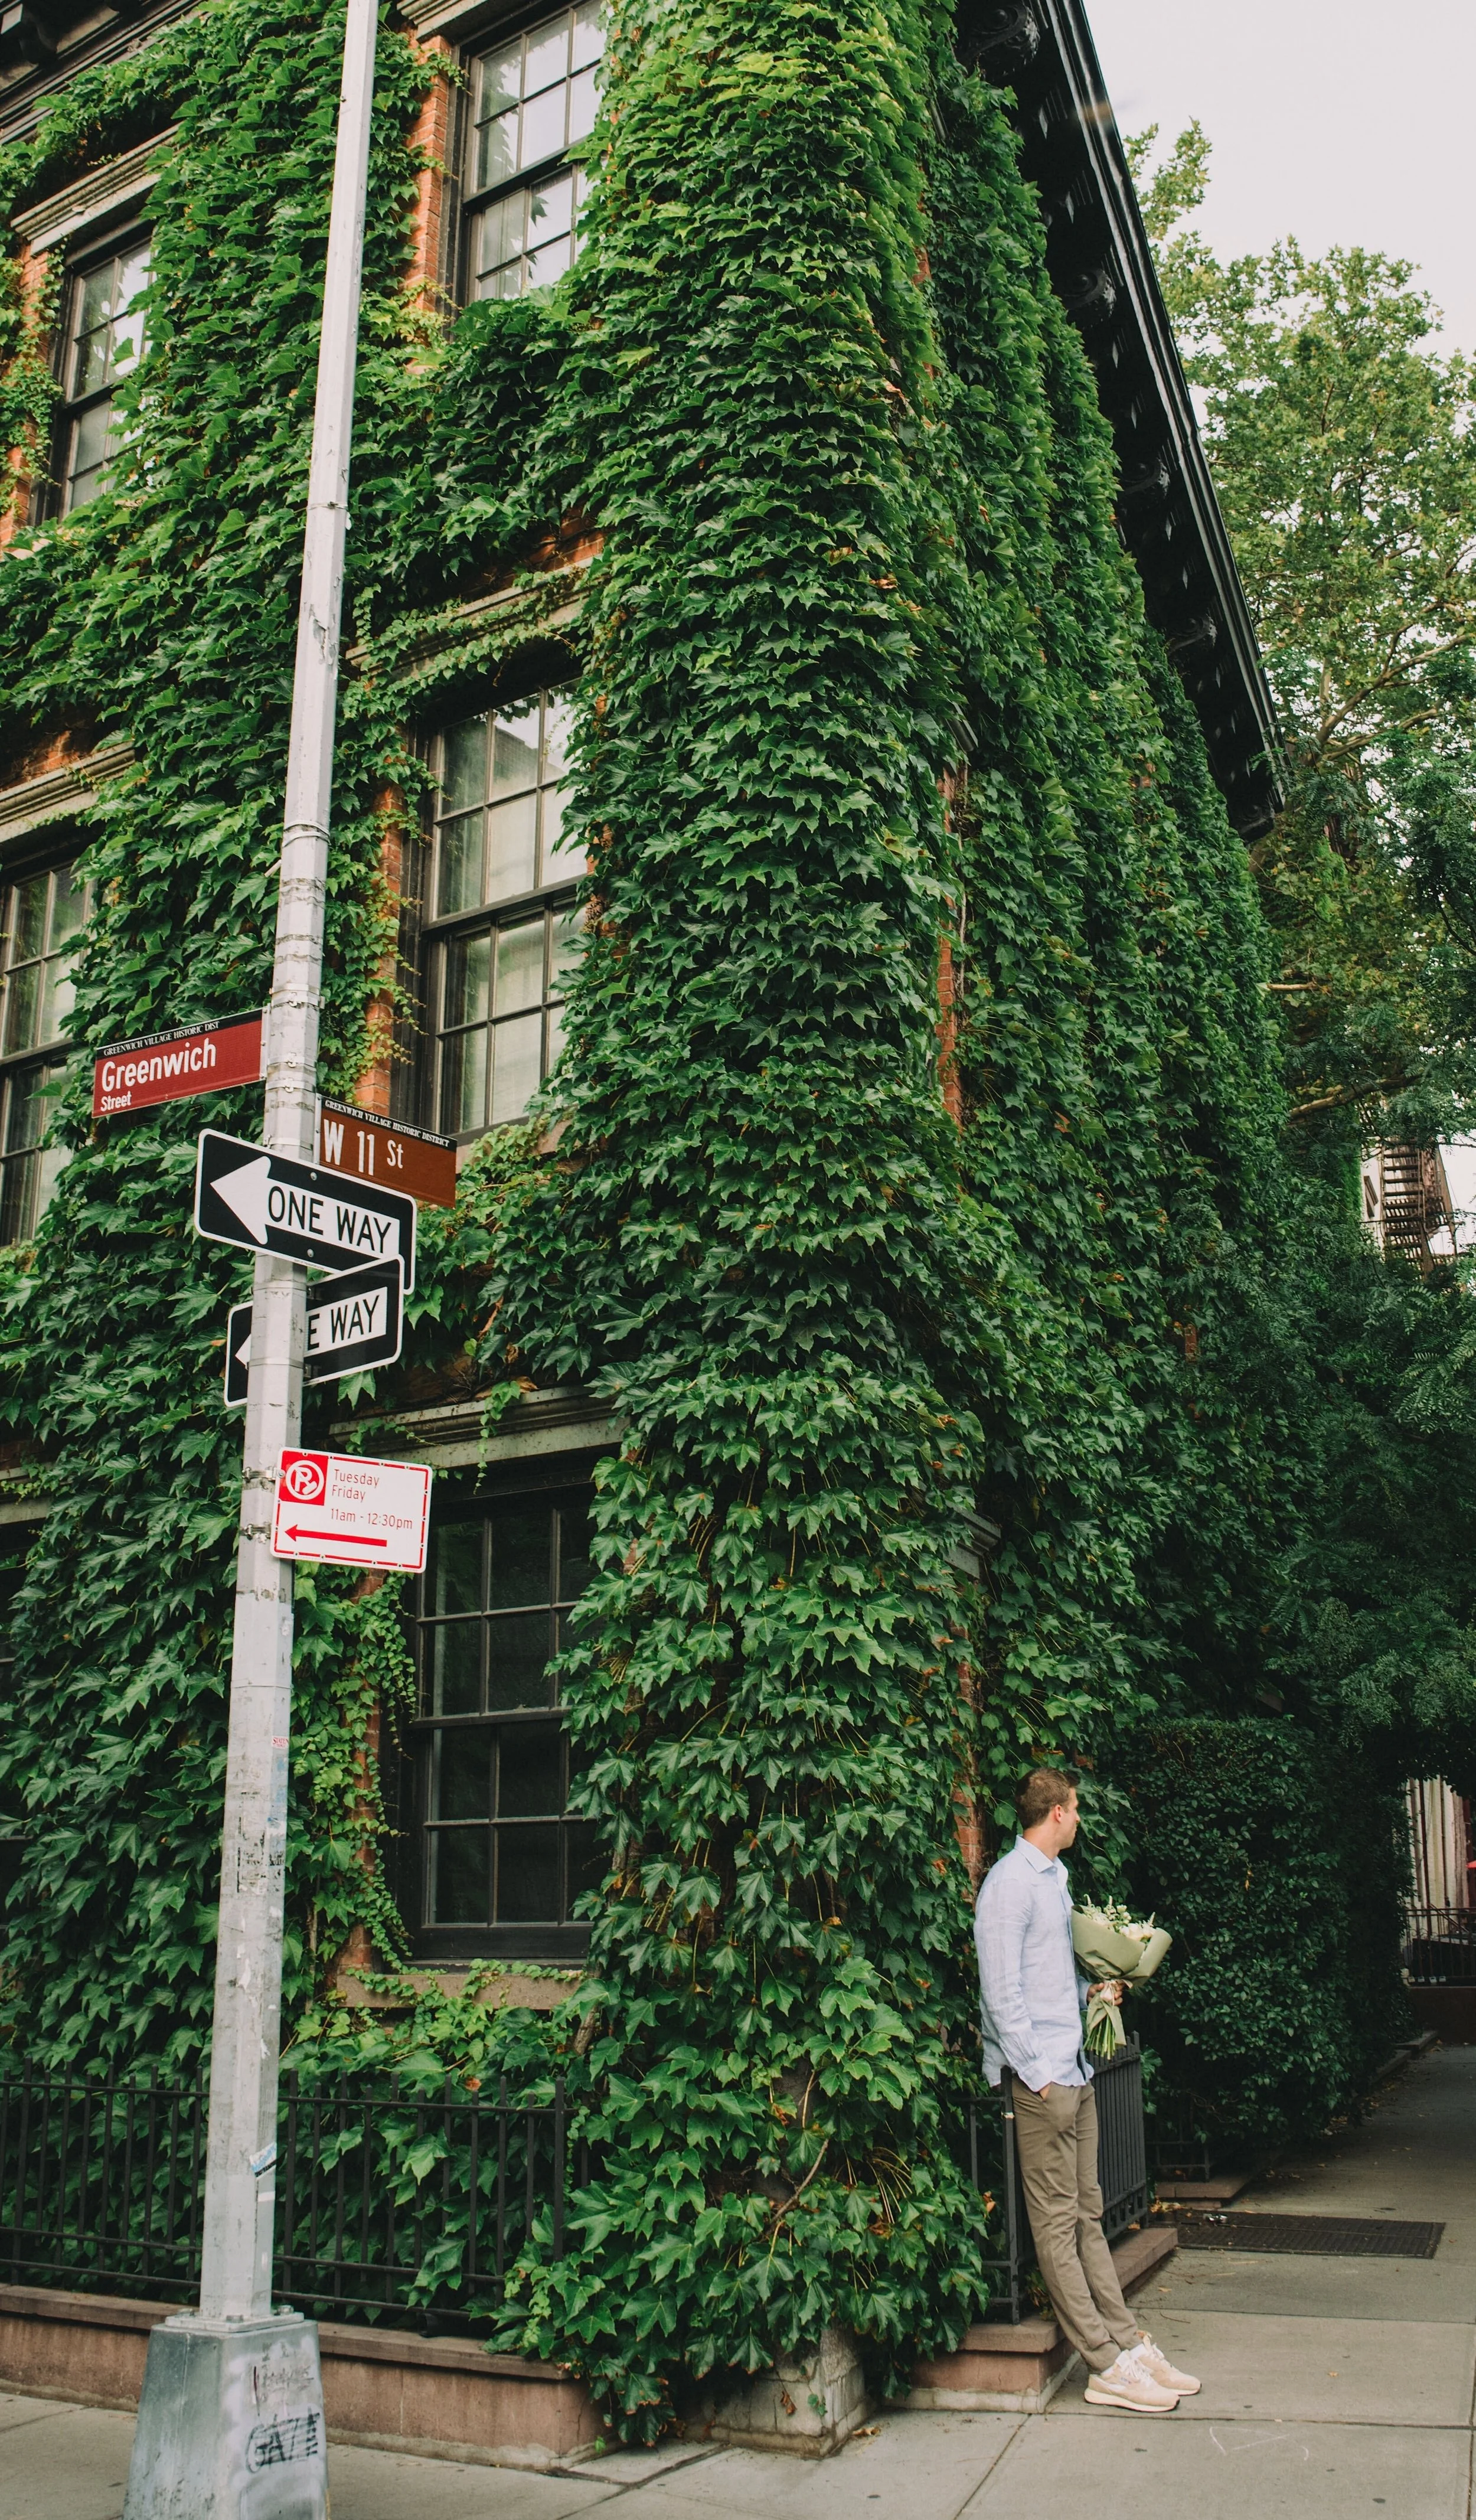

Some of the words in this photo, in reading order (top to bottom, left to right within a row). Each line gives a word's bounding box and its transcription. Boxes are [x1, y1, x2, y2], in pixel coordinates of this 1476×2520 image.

[103, 1040, 143, 1056] GREENWICH
[144, 1033, 172, 1046] VILLAGE
[174, 1025, 203, 1039] HISTORIC
[204, 1021, 220, 1031] DIST
[102, 1038, 216, 1092] Greenwich
[100, 1091, 132, 1112] Street
[325, 1099, 363, 1119] GREENWICH
[365, 1112, 391, 1128] VILLAGE
[393, 1122, 422, 1137] HISTORIC
[422, 1133, 450, 1147] DISTRICT
[324, 1119, 344, 1166] W
[357, 1130, 374, 1176] 11
[387, 1139, 404, 1169] St
[268, 1186, 324, 1236] ONE
[337, 1206, 391, 1254] WAY
[331, 1295, 380, 1343] WAY
[332, 1484, 366, 1503] Friday
[334, 1468, 380, 1488] Tuesday
[331, 1509, 355, 1522] 11am
[367, 1513, 413, 1530] 12:30pm
